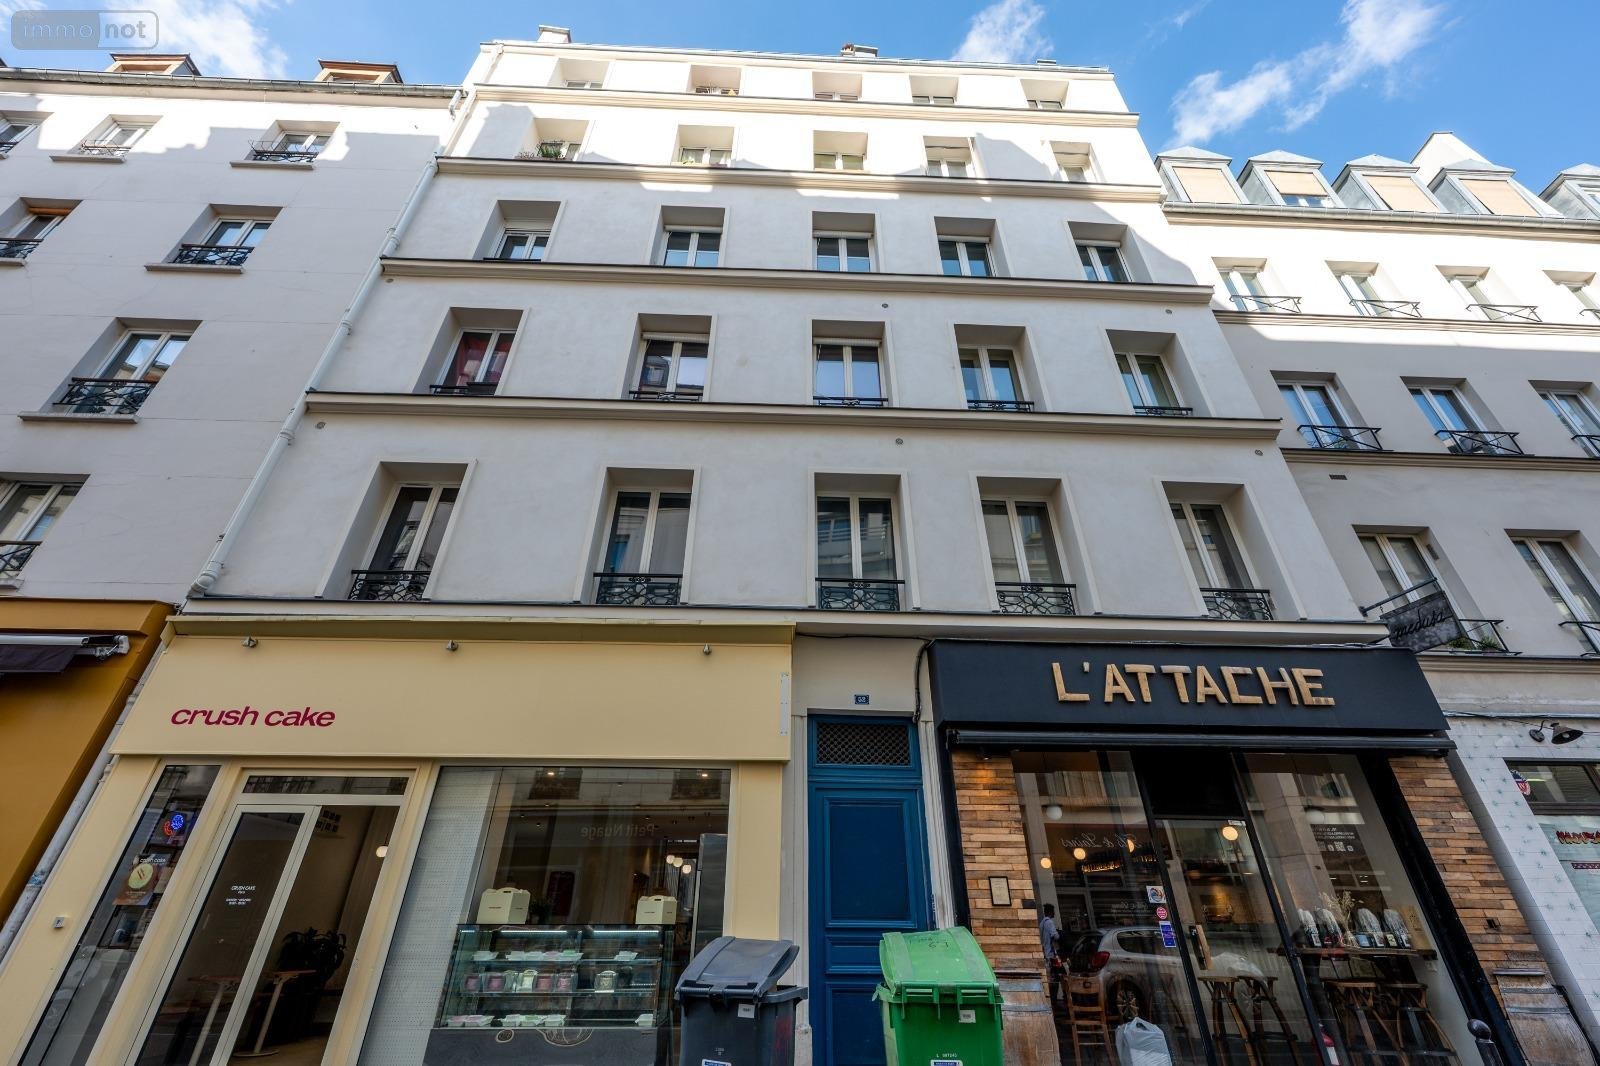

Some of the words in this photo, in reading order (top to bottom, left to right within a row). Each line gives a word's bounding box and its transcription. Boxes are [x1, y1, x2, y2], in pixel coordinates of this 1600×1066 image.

[1052, 661, 1335, 706] L'ATTACHE
[170, 705, 260, 726] crush
[264, 706, 336, 727] cake
